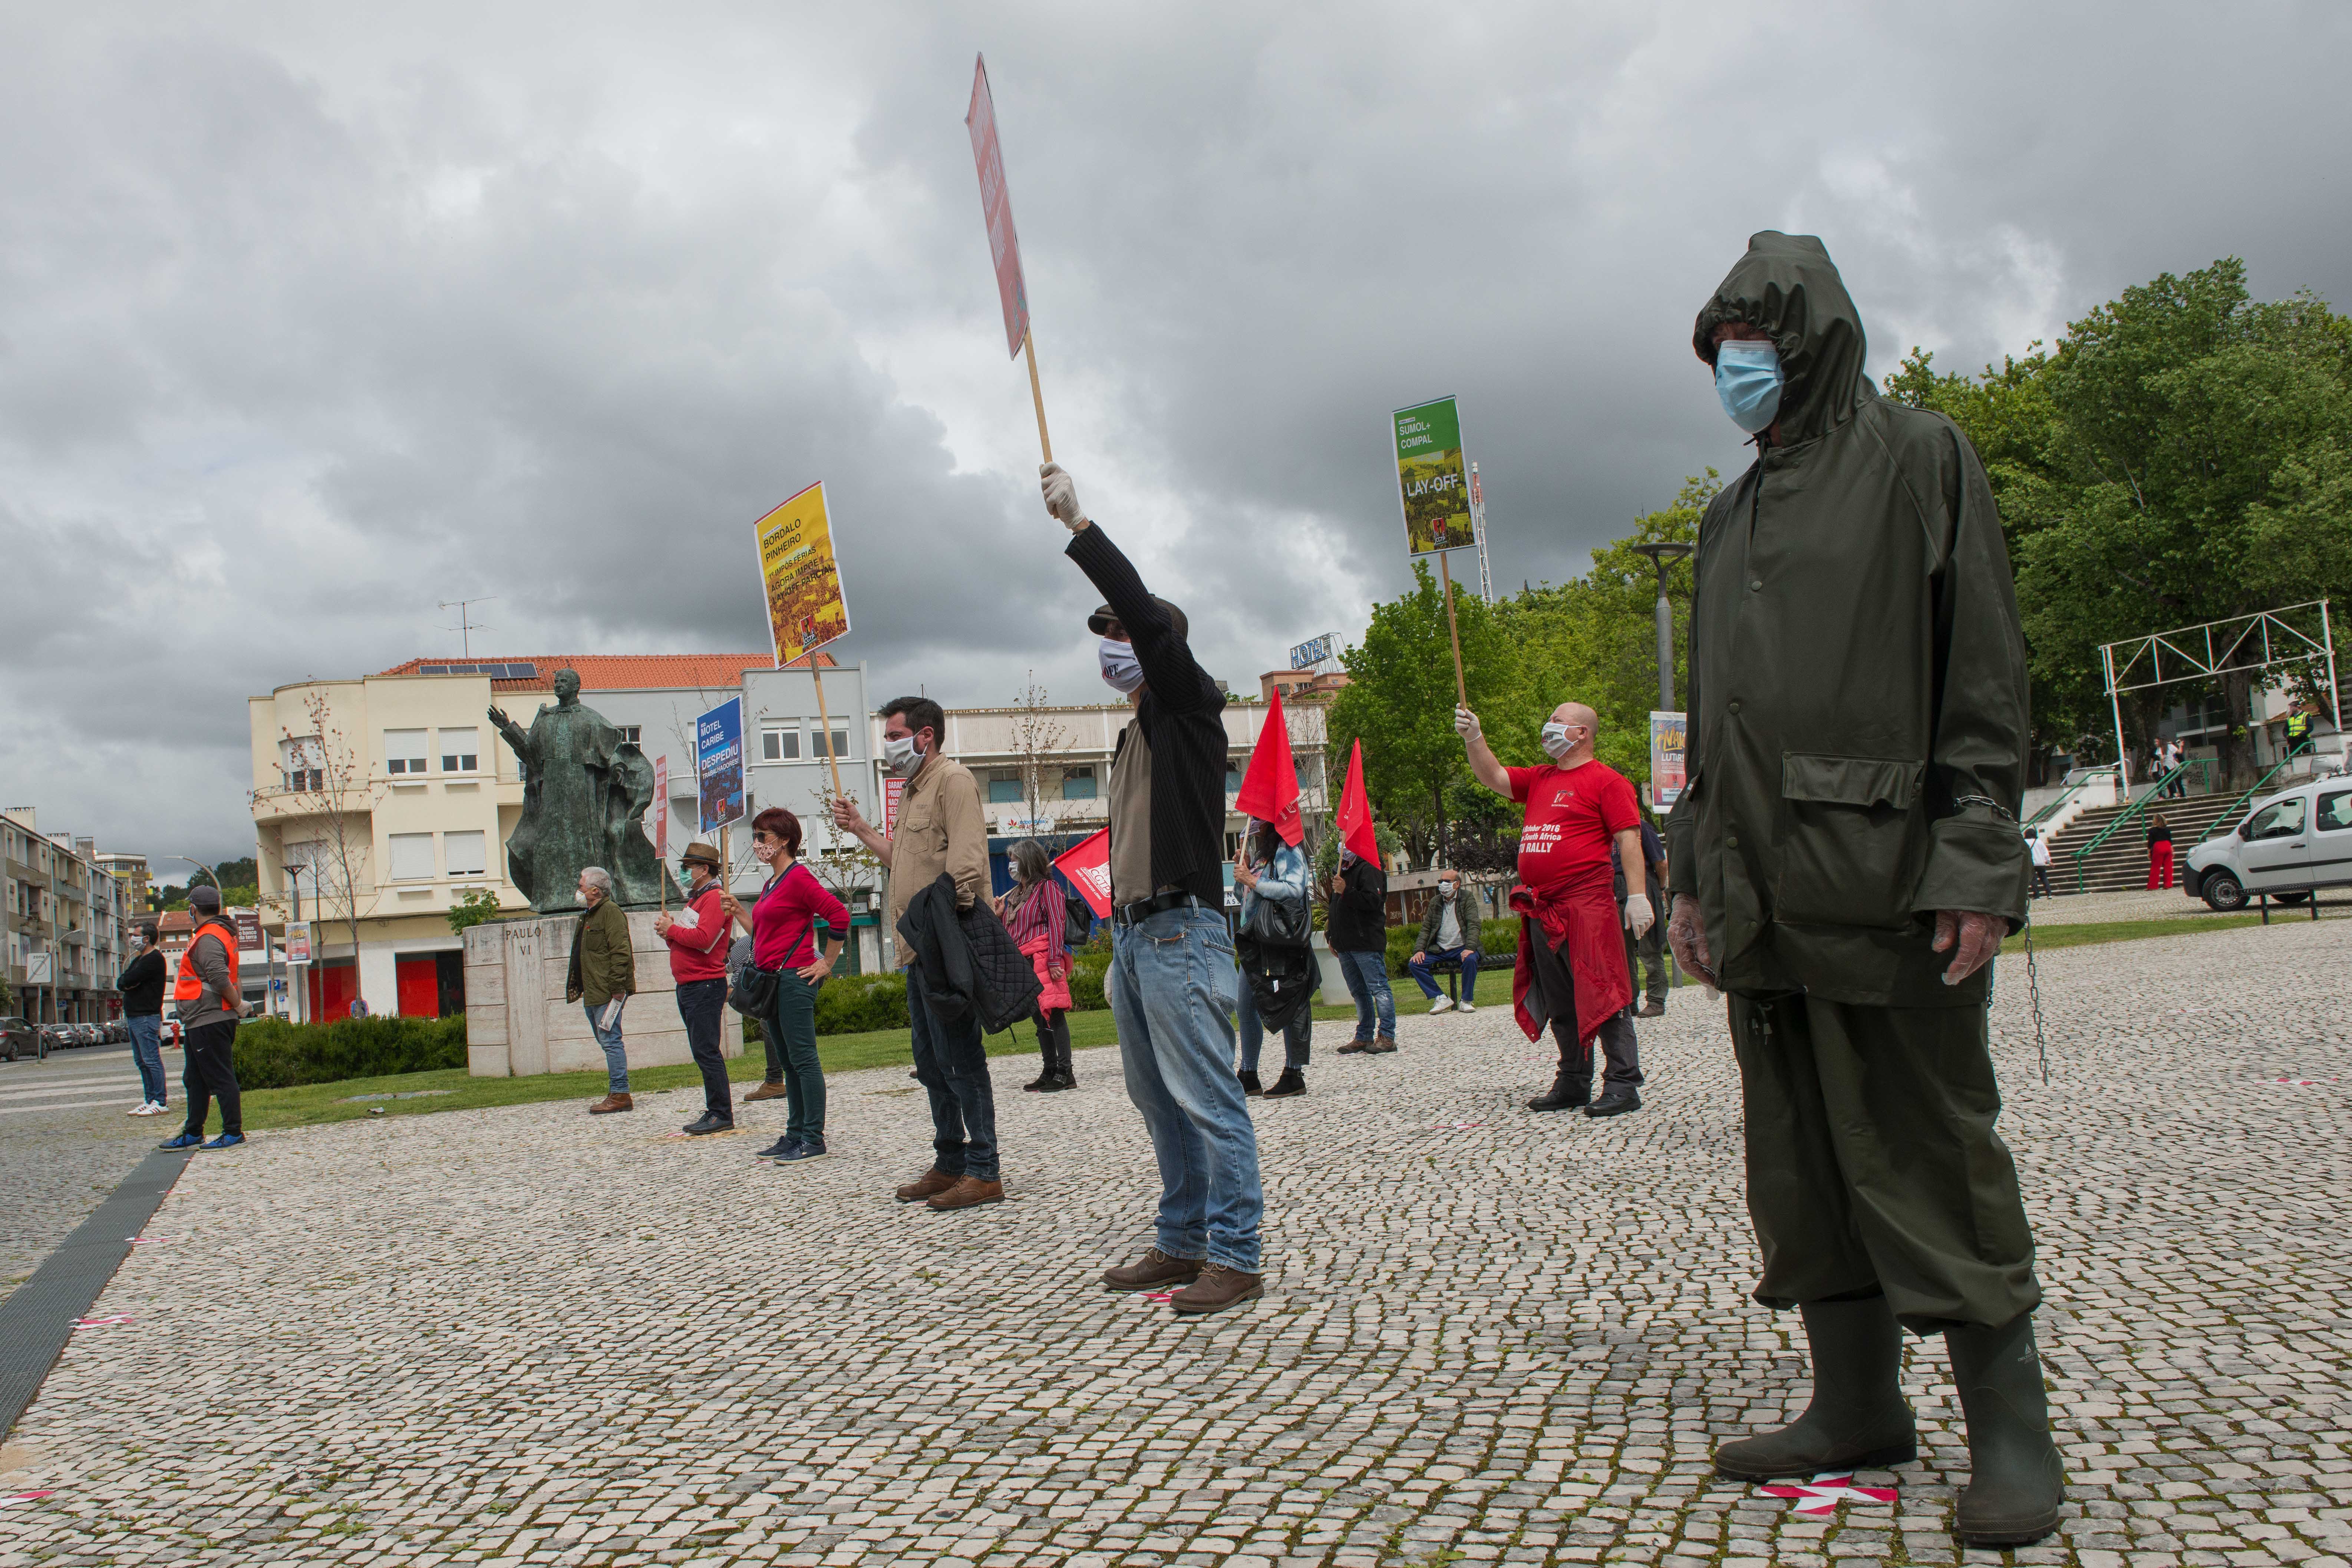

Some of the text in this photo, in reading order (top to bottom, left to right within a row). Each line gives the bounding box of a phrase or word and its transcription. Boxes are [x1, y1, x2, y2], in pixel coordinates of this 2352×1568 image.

[981, 135, 1001, 220] ABRIL EM
[1399, 421, 1430, 436] SUMOL+
[1401, 434, 1432, 449] COMPAL
[1406, 473, 1458, 497] LAY-OFF
[764, 519, 801, 549] BORDALO
[766, 533, 801, 562] PINHEIRO
[775, 560, 792, 577] IMPÔS
[794, 546, 816, 564] FÉRIAS
[772, 558, 819, 592] AGORA IMPÕE
[773, 563, 834, 605] LAY-OFF PARCIAL
[804, 634, 815, 643] CGTP
[1291, 636, 1327, 668] HOTEL
[701, 720, 722, 737] MOTEL
[702, 731, 724, 749] CARIBE
[702, 744, 738, 770] DESPEDIU
[1661, 753, 1684, 762] LUTAR!
[702, 758, 739, 779] TRABALHADORES!
[1524, 825, 1541, 833] October
[1541, 824, 1560, 832] 2016
[1526, 842, 1553, 853] RALLY
[1075, 869, 1102, 900] UNIÃO SINDICATOS LEIRIA
[1091, 869, 1111, 890] CGTP
[506, 927, 542, 940] PAULO
[521, 945, 531, 955] VI
